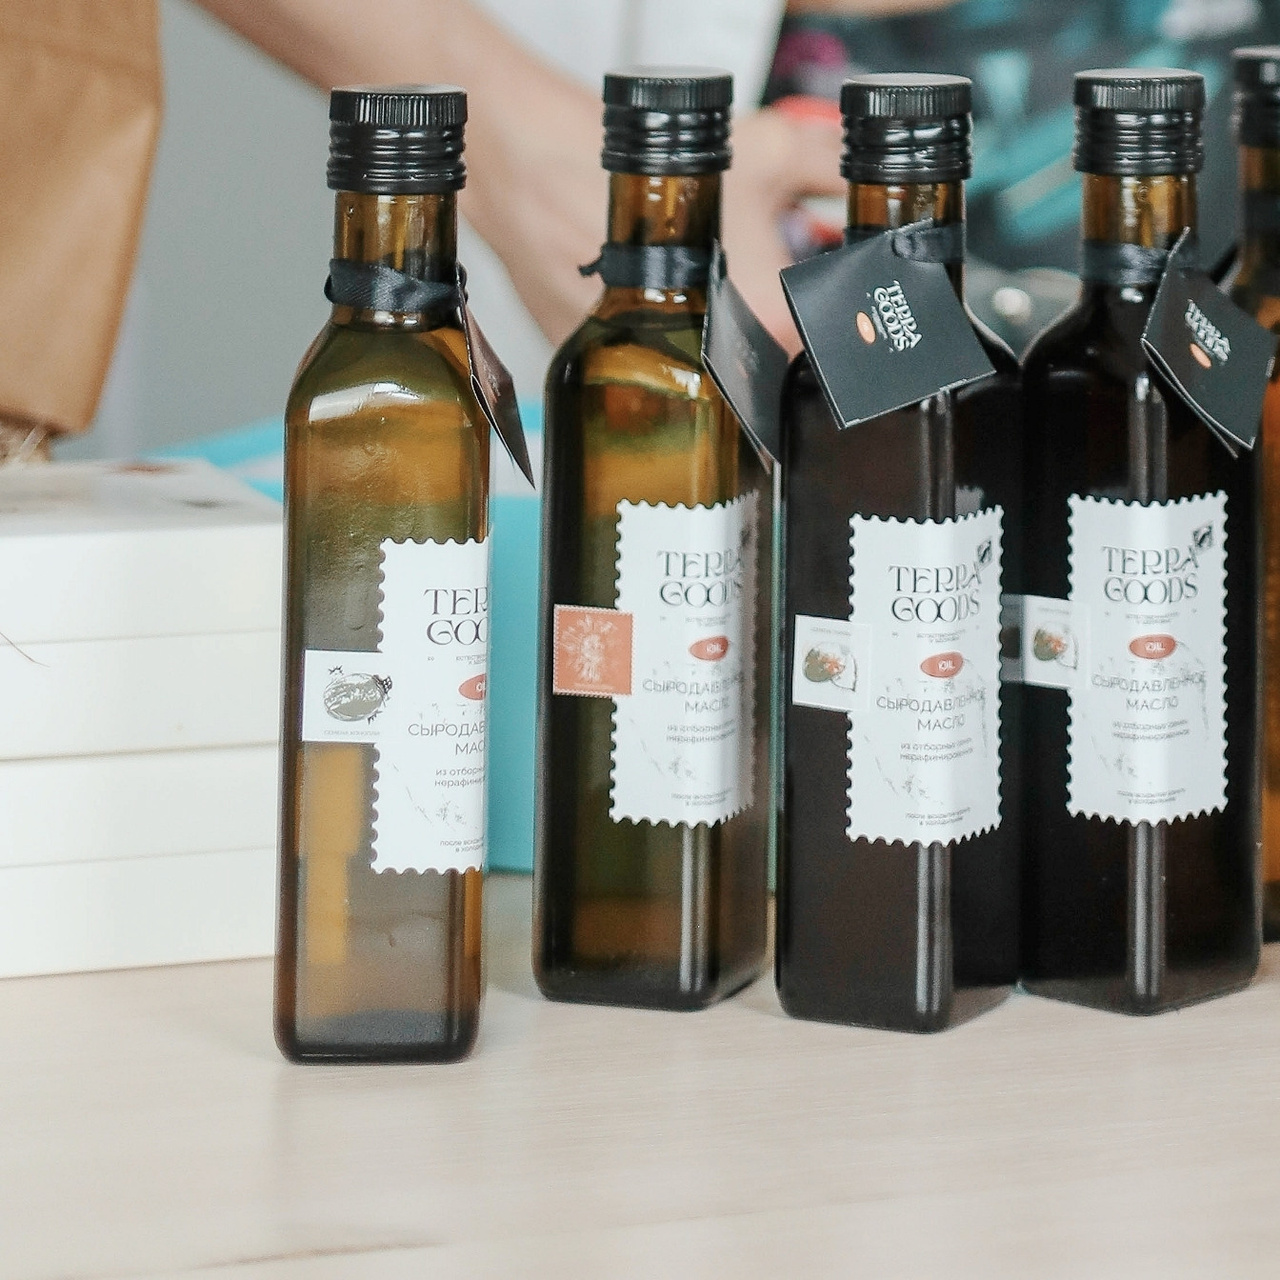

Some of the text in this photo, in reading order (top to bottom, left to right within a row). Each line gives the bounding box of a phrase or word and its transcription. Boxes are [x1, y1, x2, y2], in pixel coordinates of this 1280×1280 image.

[874, 287, 910, 352] GOODS
[887, 280, 923, 349] TERRA
[1102, 545, 1199, 575] TERRA
[888, 561, 982, 593] TERRA
[1104, 573, 1198, 605] GOODS
[891, 590, 980, 624] GOODS
[1126, 696, 1179, 711] МАСЛО
